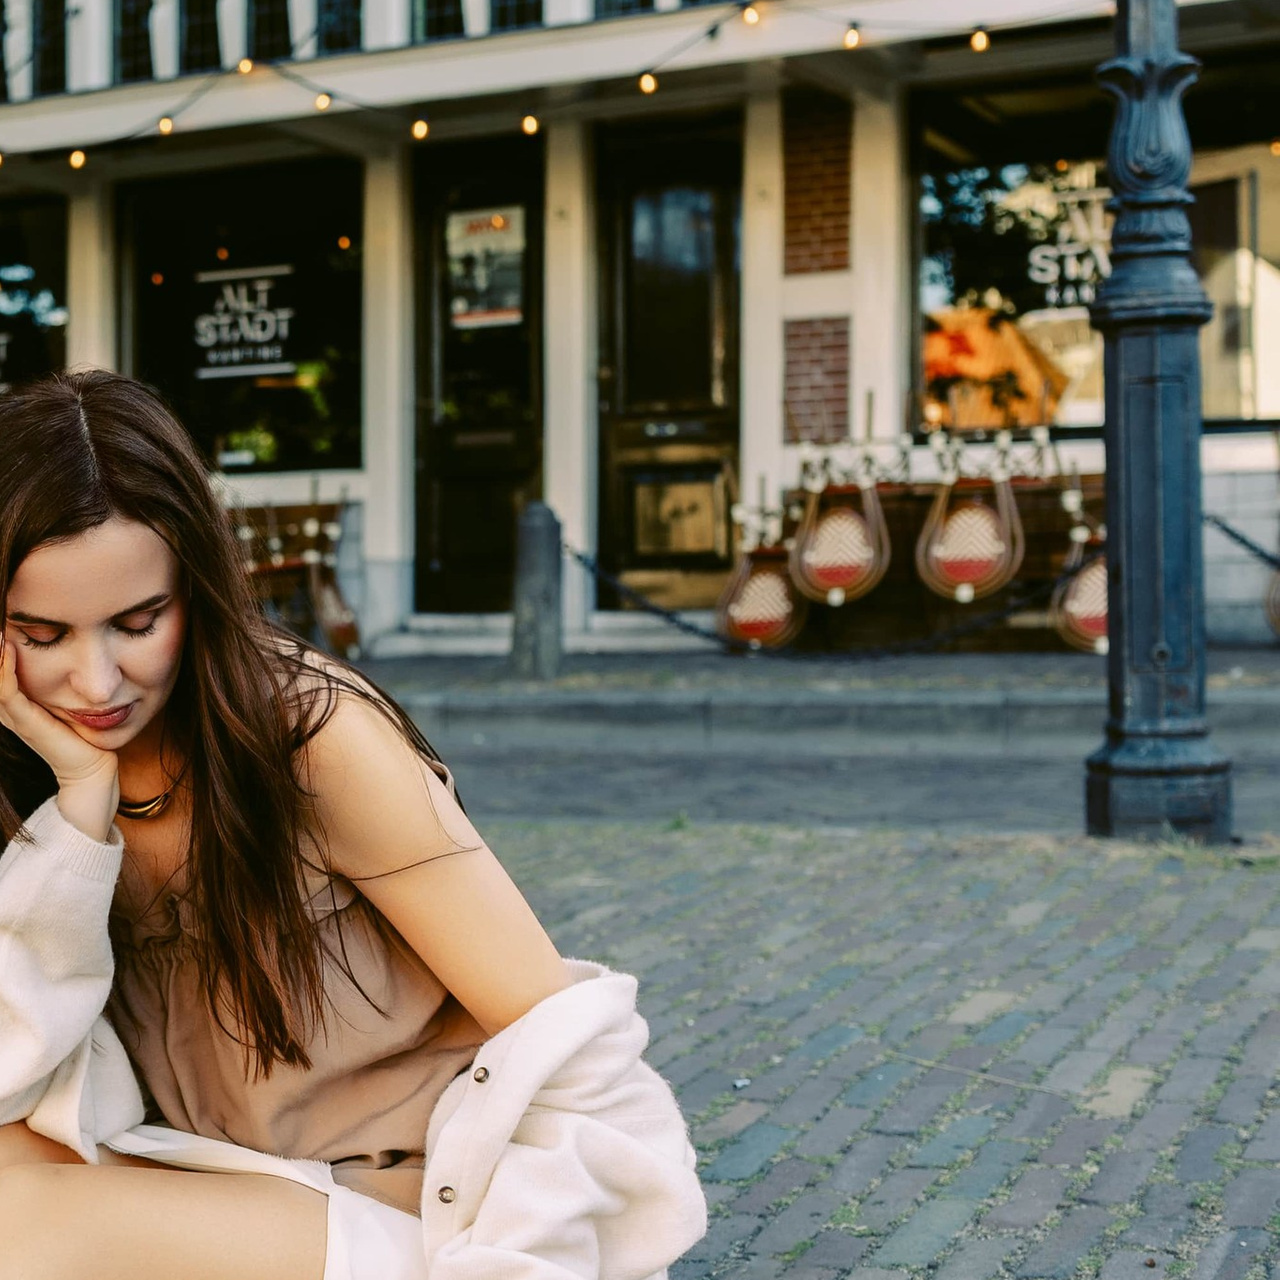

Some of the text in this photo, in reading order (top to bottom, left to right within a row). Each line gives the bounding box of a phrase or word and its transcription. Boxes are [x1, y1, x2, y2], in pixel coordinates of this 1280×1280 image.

[1058, 204, 1112, 257] AL
[1028, 244, 1113, 283] STA
[215, 279, 275, 315] ALT
[195, 307, 295, 347] STADT
